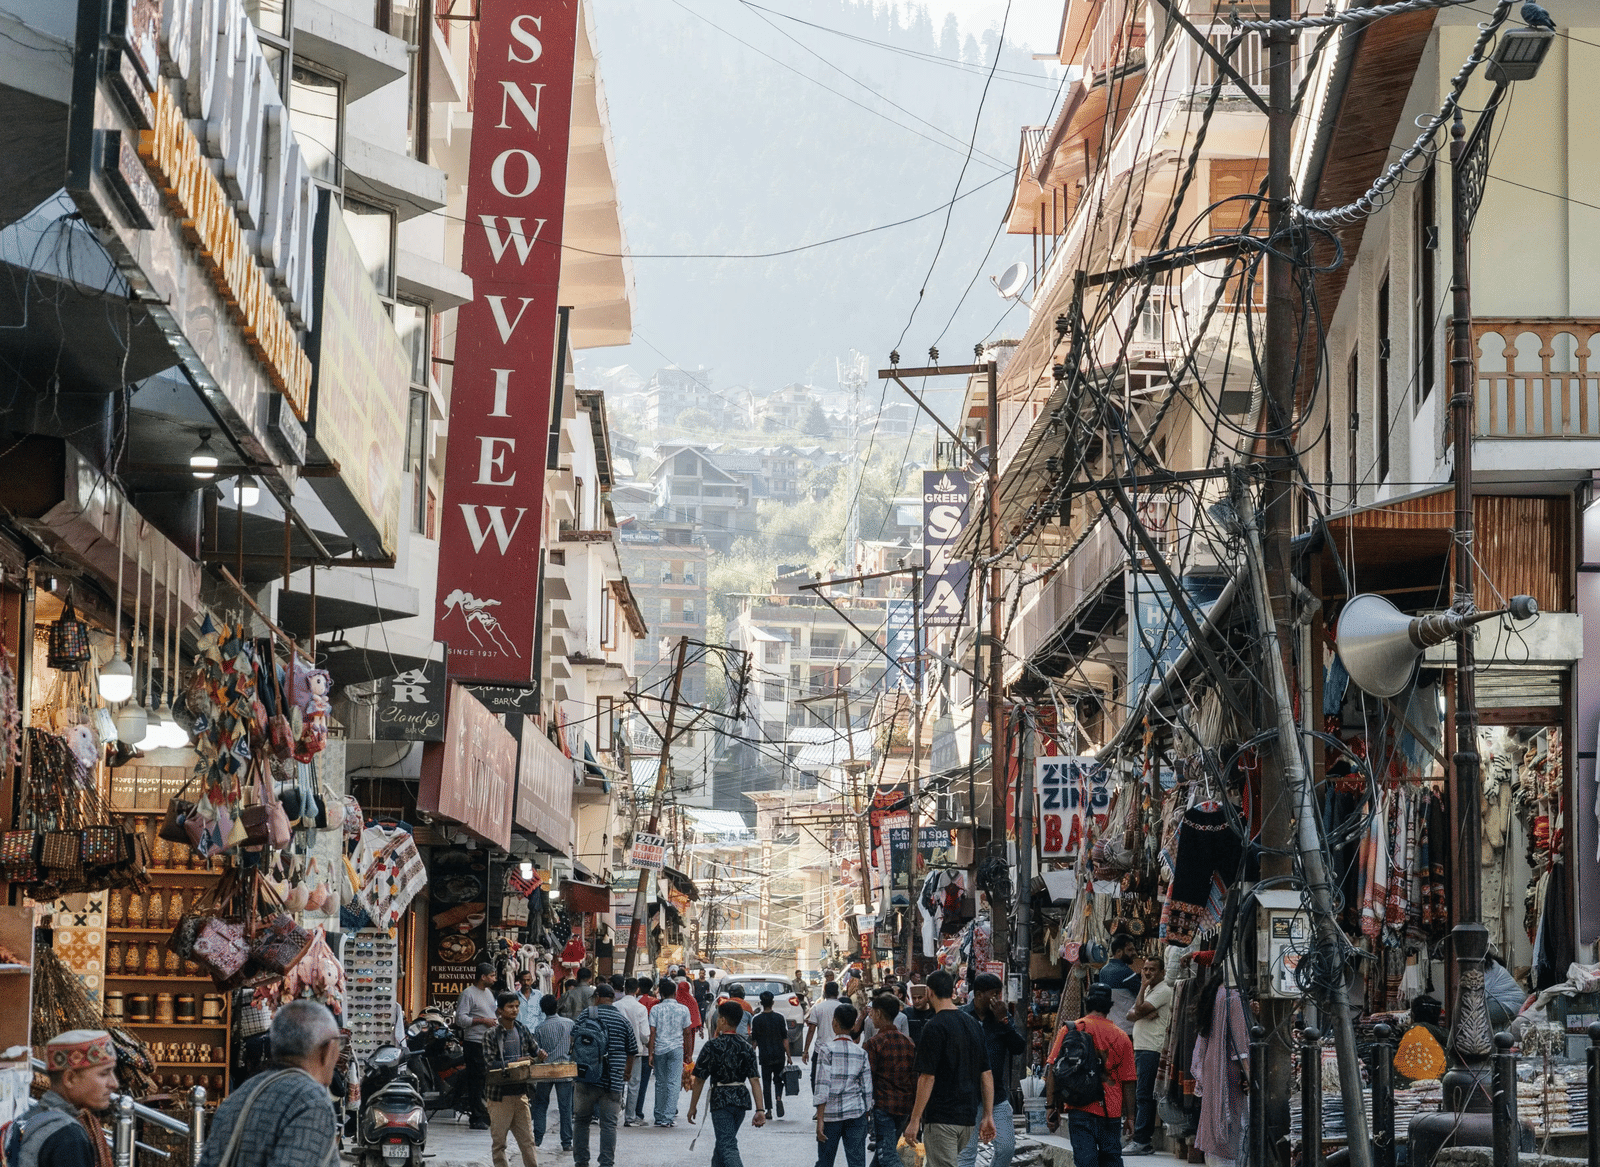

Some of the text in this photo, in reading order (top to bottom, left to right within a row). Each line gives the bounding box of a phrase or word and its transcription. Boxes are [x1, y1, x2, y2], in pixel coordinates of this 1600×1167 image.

[924, 493, 967, 503] GREEN
[923, 505, 967, 615] SPA
[447, 648, 498, 658] SINCE 1937
[379, 705, 428, 724] Cloud
[1042, 763, 1107, 785] ZING
[1042, 787, 1109, 810] ZING
[638, 834, 663, 846] 24/7
[928, 829, 949, 842] spa
[635, 843, 663, 854] FOOD
[632, 850, 662, 862] DELIVERY
